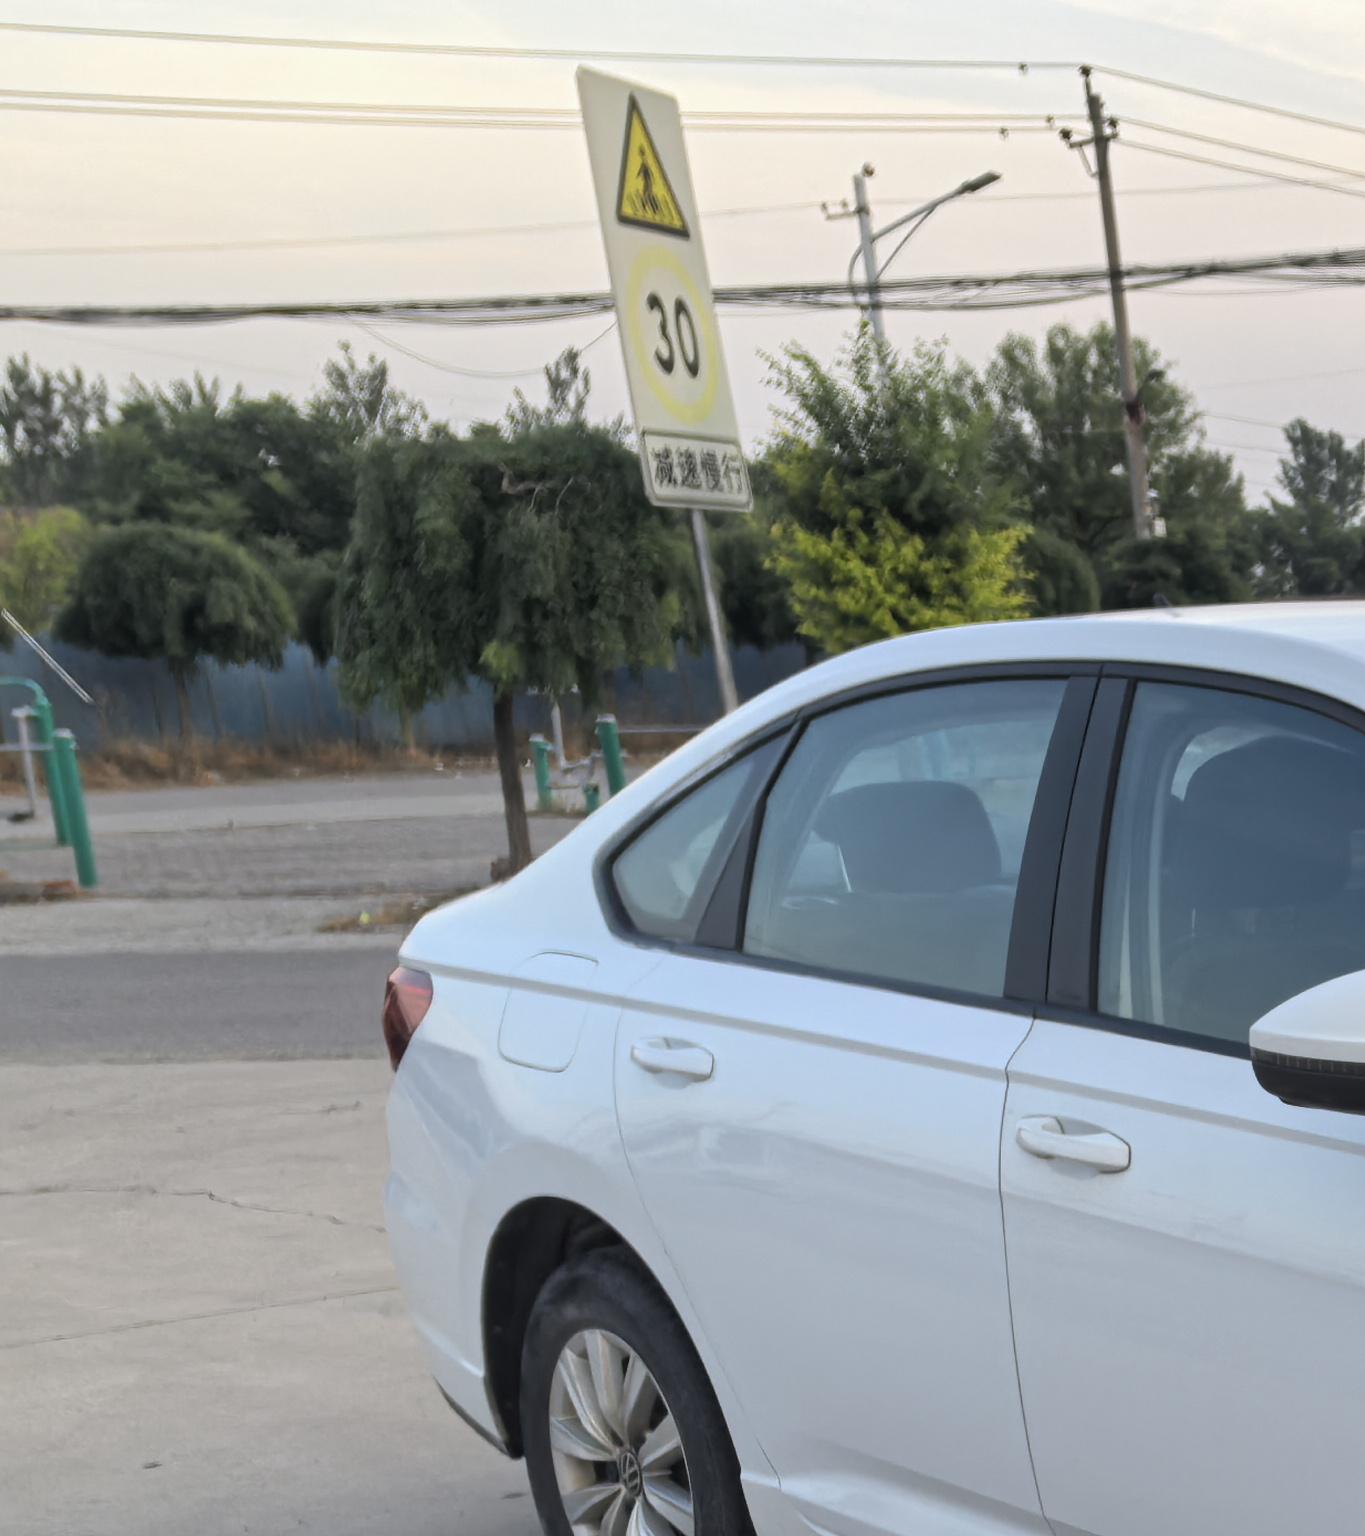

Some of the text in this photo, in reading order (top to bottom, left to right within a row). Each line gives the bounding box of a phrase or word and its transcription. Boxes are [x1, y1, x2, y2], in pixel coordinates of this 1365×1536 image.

[646, 292, 700, 379] 30
[652, 445, 743, 494] 减速慢行
